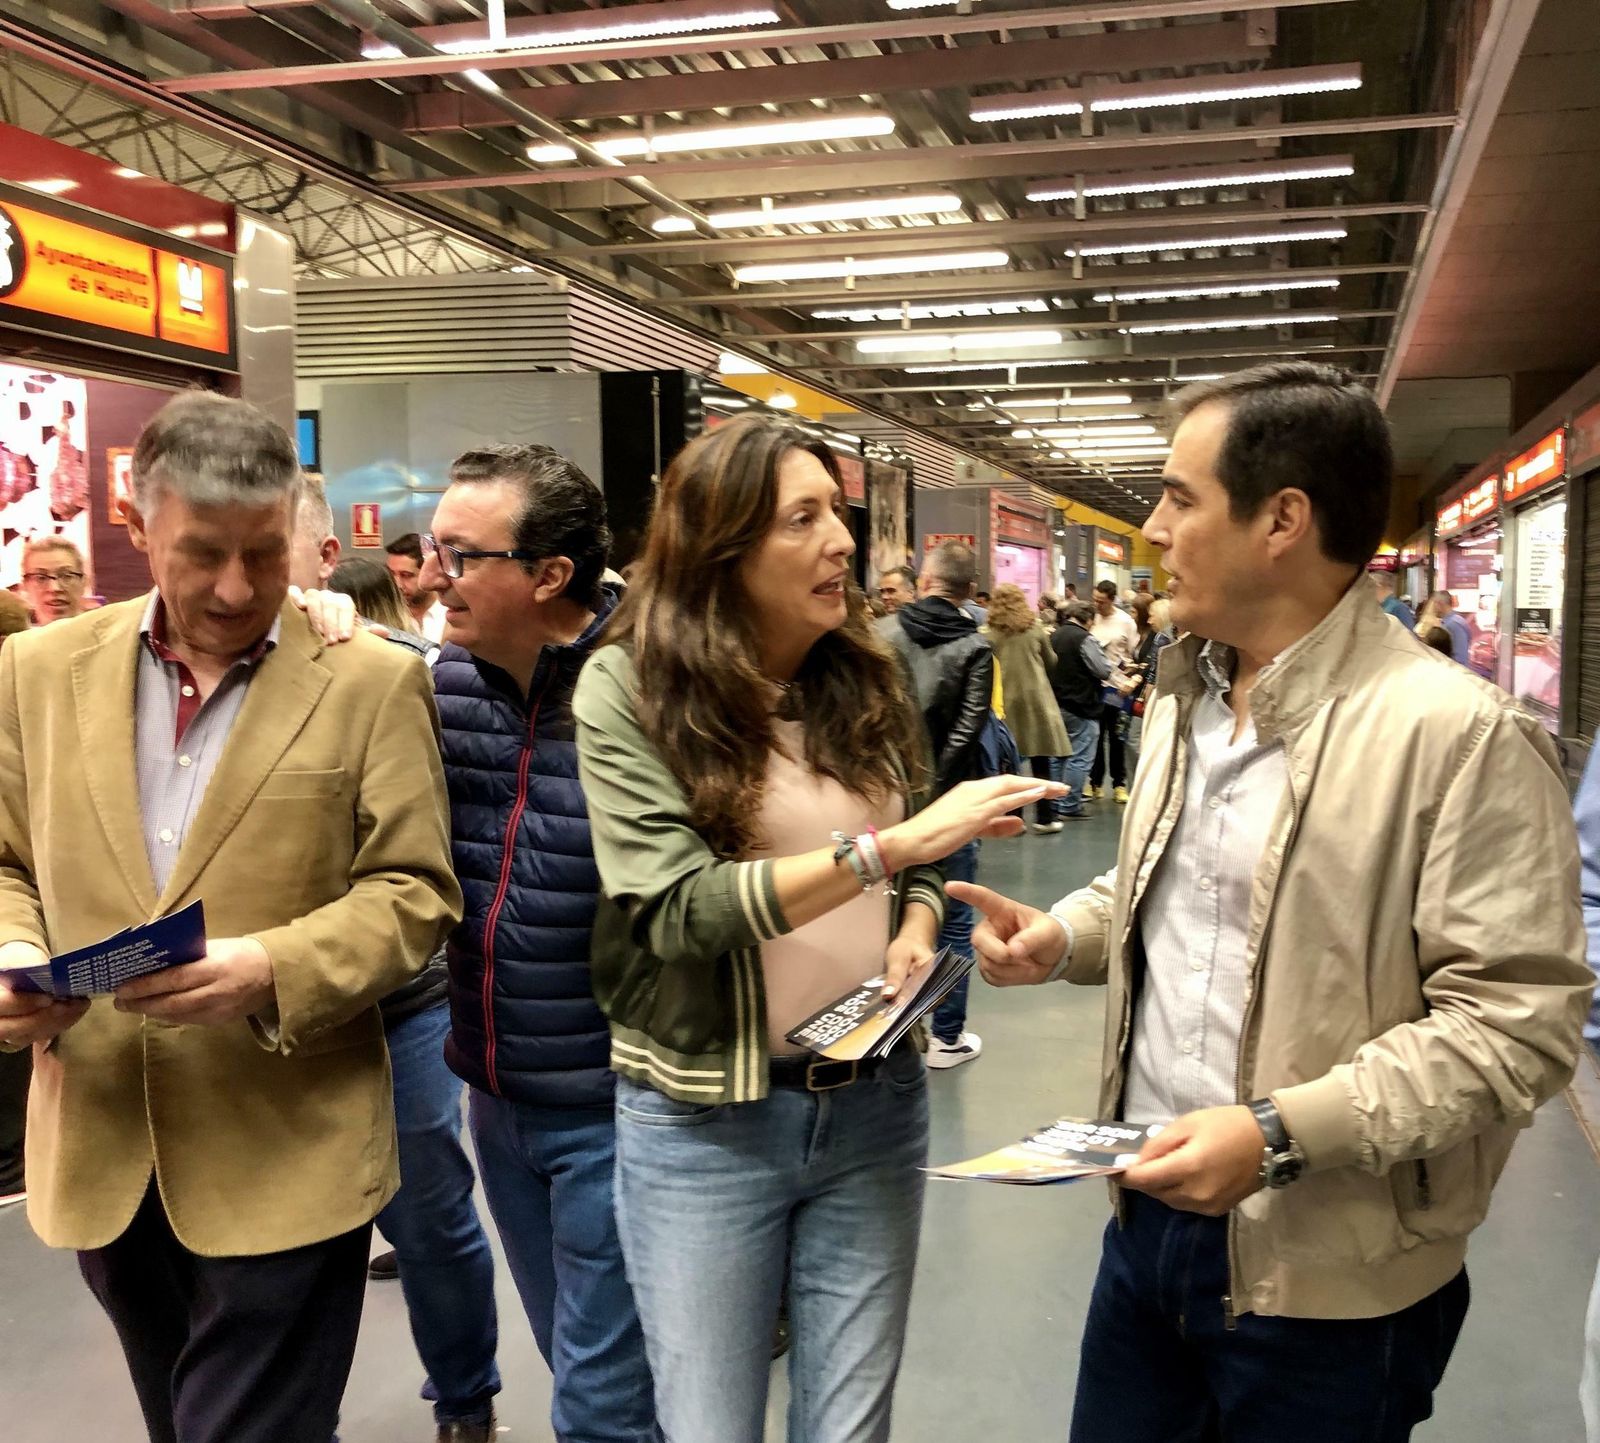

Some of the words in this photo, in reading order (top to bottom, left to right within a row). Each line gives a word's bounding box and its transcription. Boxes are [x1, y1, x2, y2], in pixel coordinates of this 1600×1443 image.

[68, 274, 89, 294] de
[68, 960, 90, 969] POR
[107, 939, 151, 957] EMPLEO.
[68, 964, 91, 974] POR
[834, 990, 873, 1012] NOS
[843, 1000, 869, 1015] LO
[805, 1016, 843, 1040] QUE
[814, 1012, 865, 1043] TODO
[820, 1022, 860, 1046] POR
